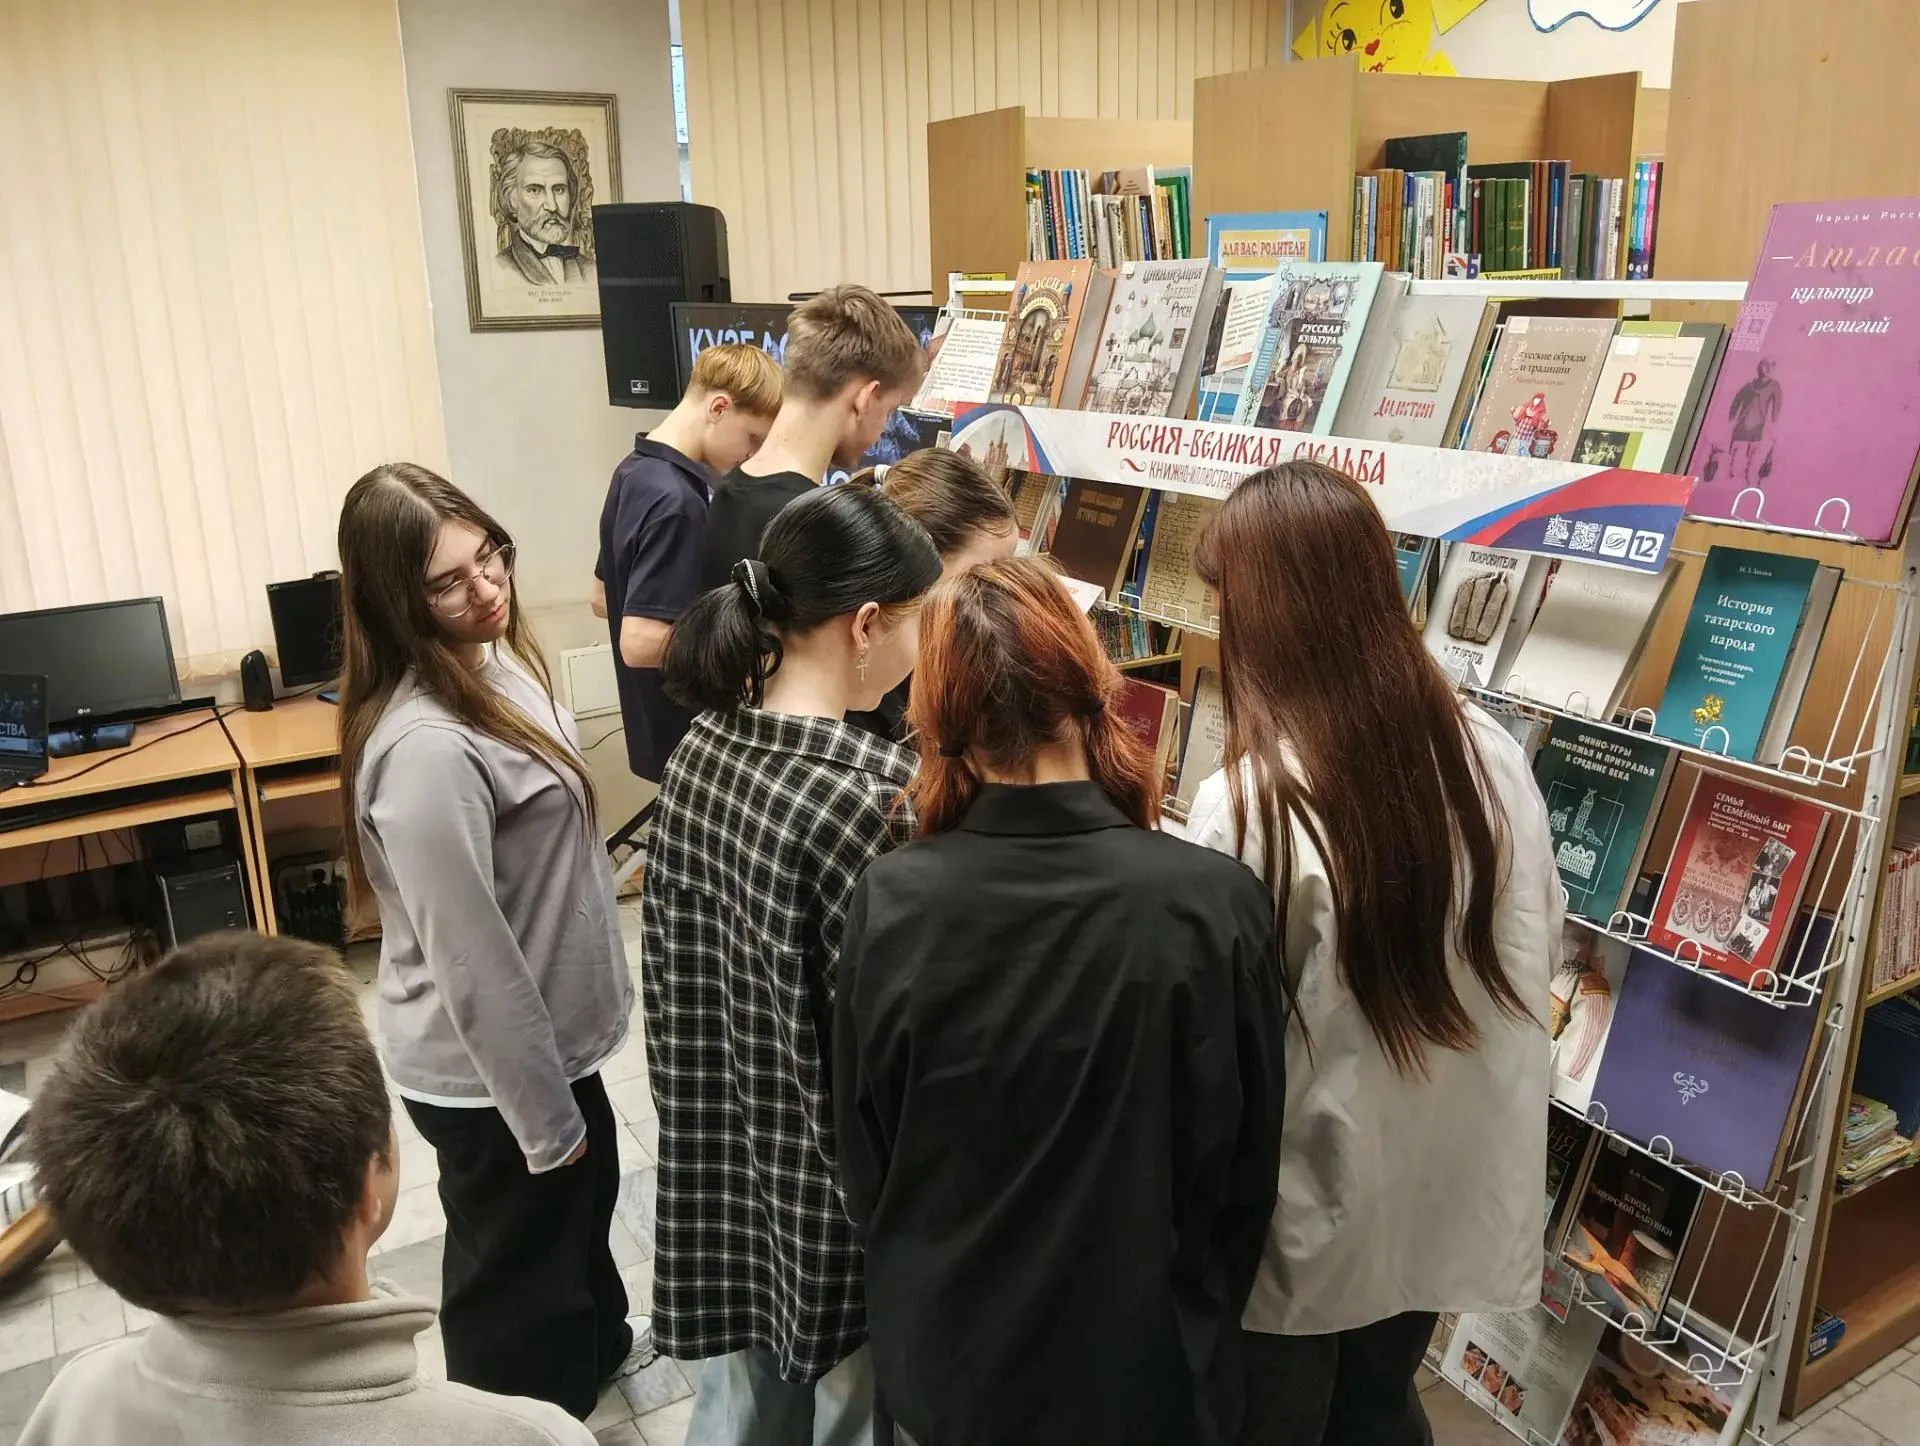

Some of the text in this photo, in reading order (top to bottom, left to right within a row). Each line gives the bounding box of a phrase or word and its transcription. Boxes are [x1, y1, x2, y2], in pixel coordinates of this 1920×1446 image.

[1222, 243, 1239, 256] ДЛЯ
[1260, 241, 1306, 257] РОДИТЕЛИ
[1791, 286, 1874, 304] культур
[1300, 323, 1342, 334] РУССКАЯ
[1808, 316, 1892, 336] религий
[1297, 334, 1337, 345] КУЛЬТУРА
[1553, 352, 1587, 364] обряды
[1107, 421, 1282, 468] РОССИЯ-ВЕЛИКАЯ
[1717, 594, 1774, 616] История
[1703, 614, 1776, 636] татарского
[1710, 634, 1756, 653] народа
[1578, 734, 1633, 758] ФИННО-УГРЫ
[1550, 737, 1656, 778] ПОВОЛЖЬЯ И ПРИУРАЛЬЯ
[1565, 753, 1631, 782] В СРЕДНИЕ ВЕКА
[1716, 792, 1745, 808] СЕМЬЯ
[1712, 800, 1720, 810] И
[1722, 804, 1771, 826] СЕМЕЙНЫЙ
[1771, 819, 1792, 834] БЫТ
